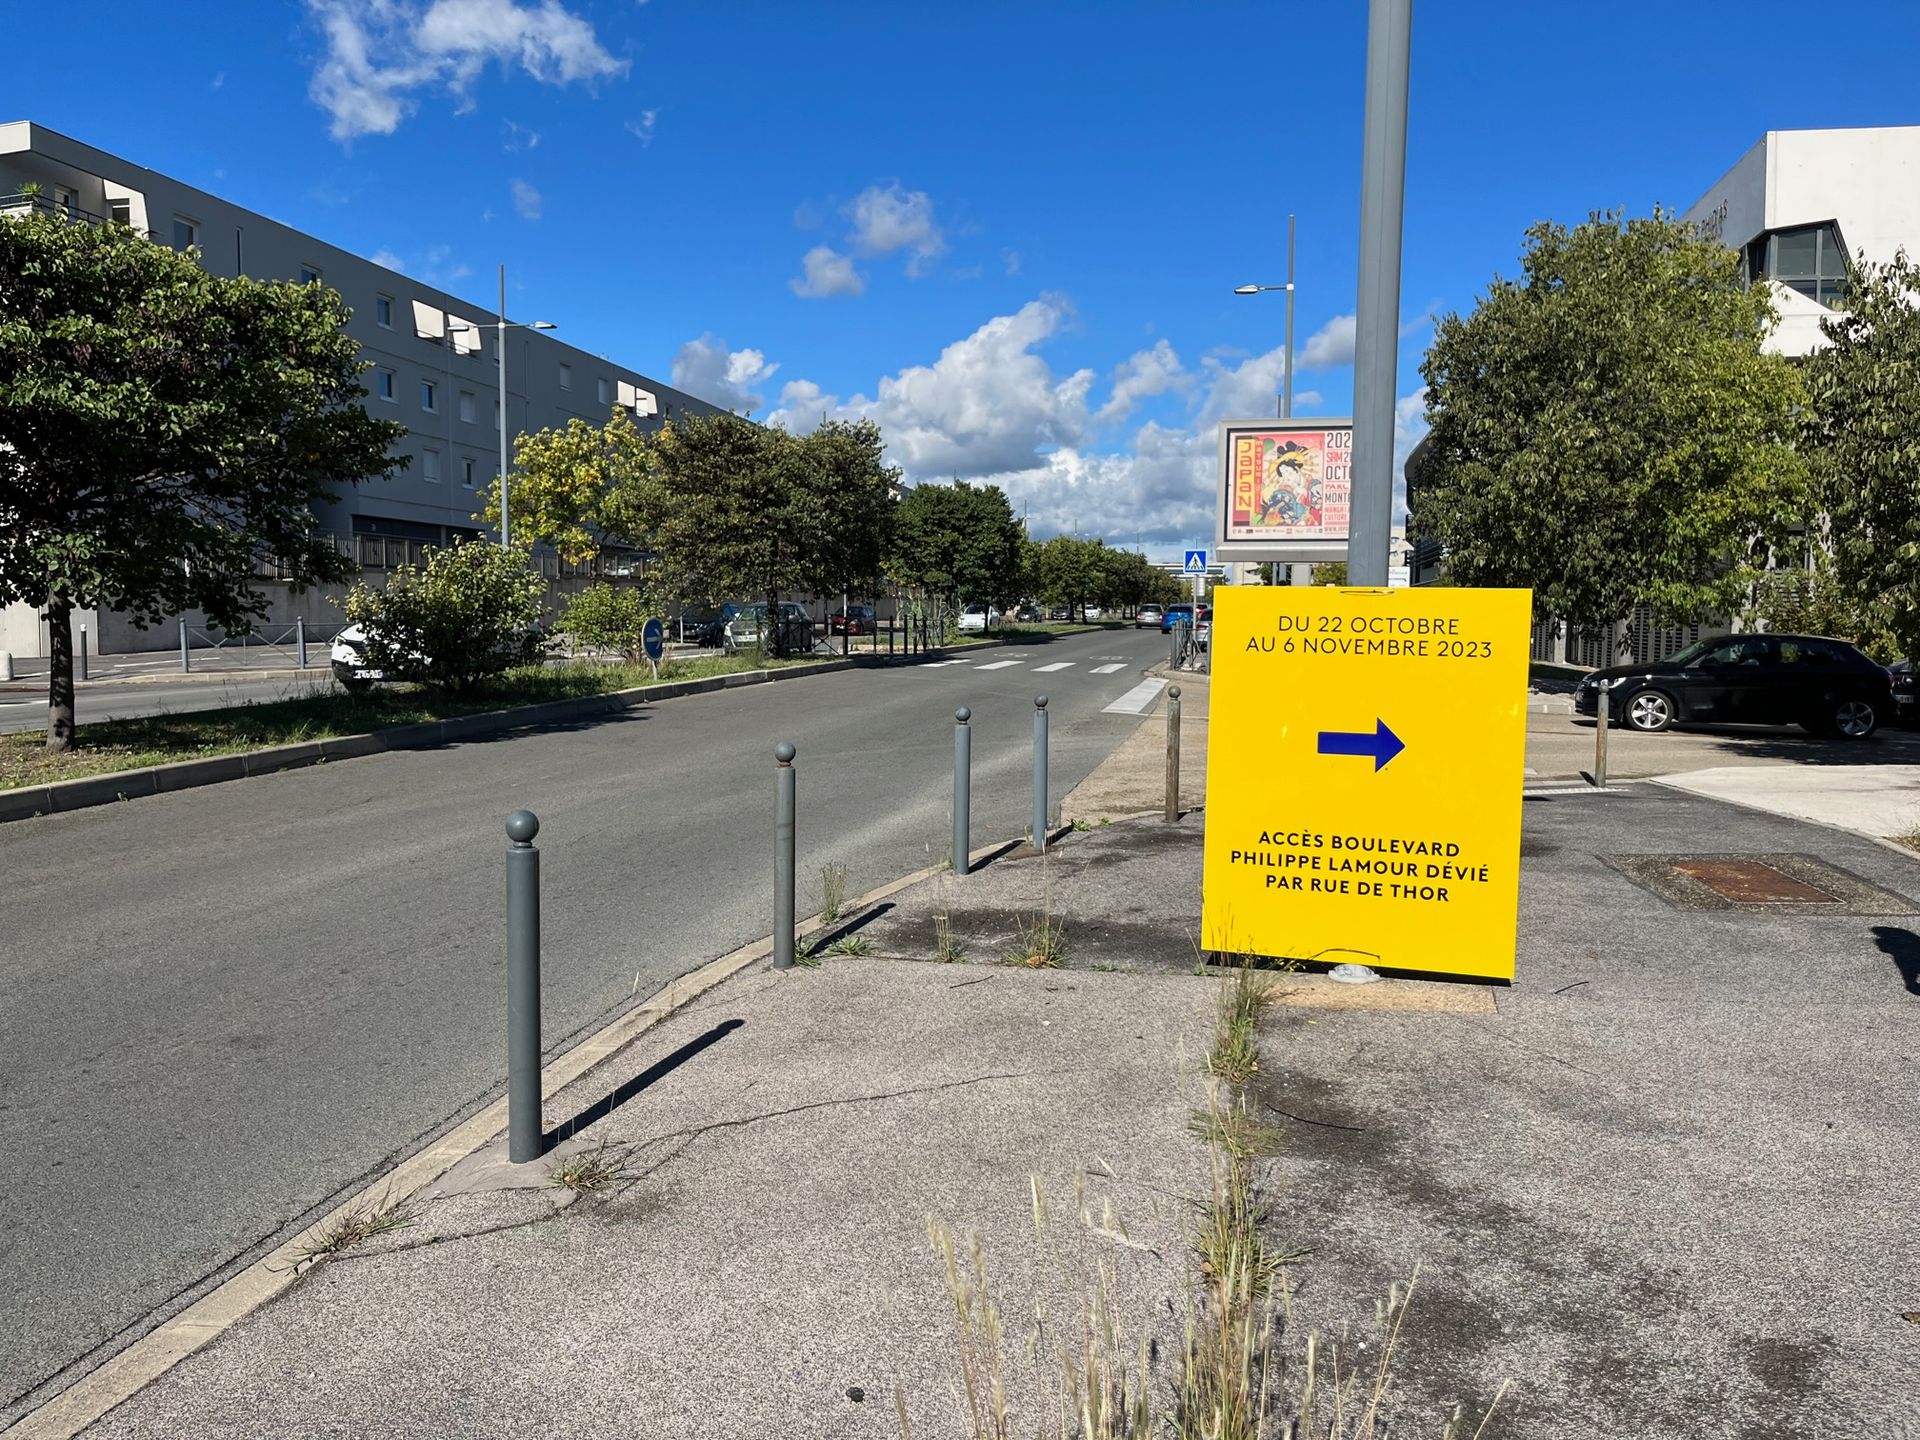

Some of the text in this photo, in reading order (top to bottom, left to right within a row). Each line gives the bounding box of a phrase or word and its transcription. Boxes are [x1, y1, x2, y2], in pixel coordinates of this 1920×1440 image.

[1326, 432, 1351, 449] 202
[1279, 615, 1459, 635] DU 22 OCTOBRE
[1246, 636, 1492, 658] AU 6 NOVEMBRE 2023
[1258, 829, 1460, 857] ACCÈS BOULEVARD
[1231, 850, 1489, 883] PHILIPPE LAMOUR DÉVIÉ
[1266, 874, 1449, 902] PAR RUE DE THOR
